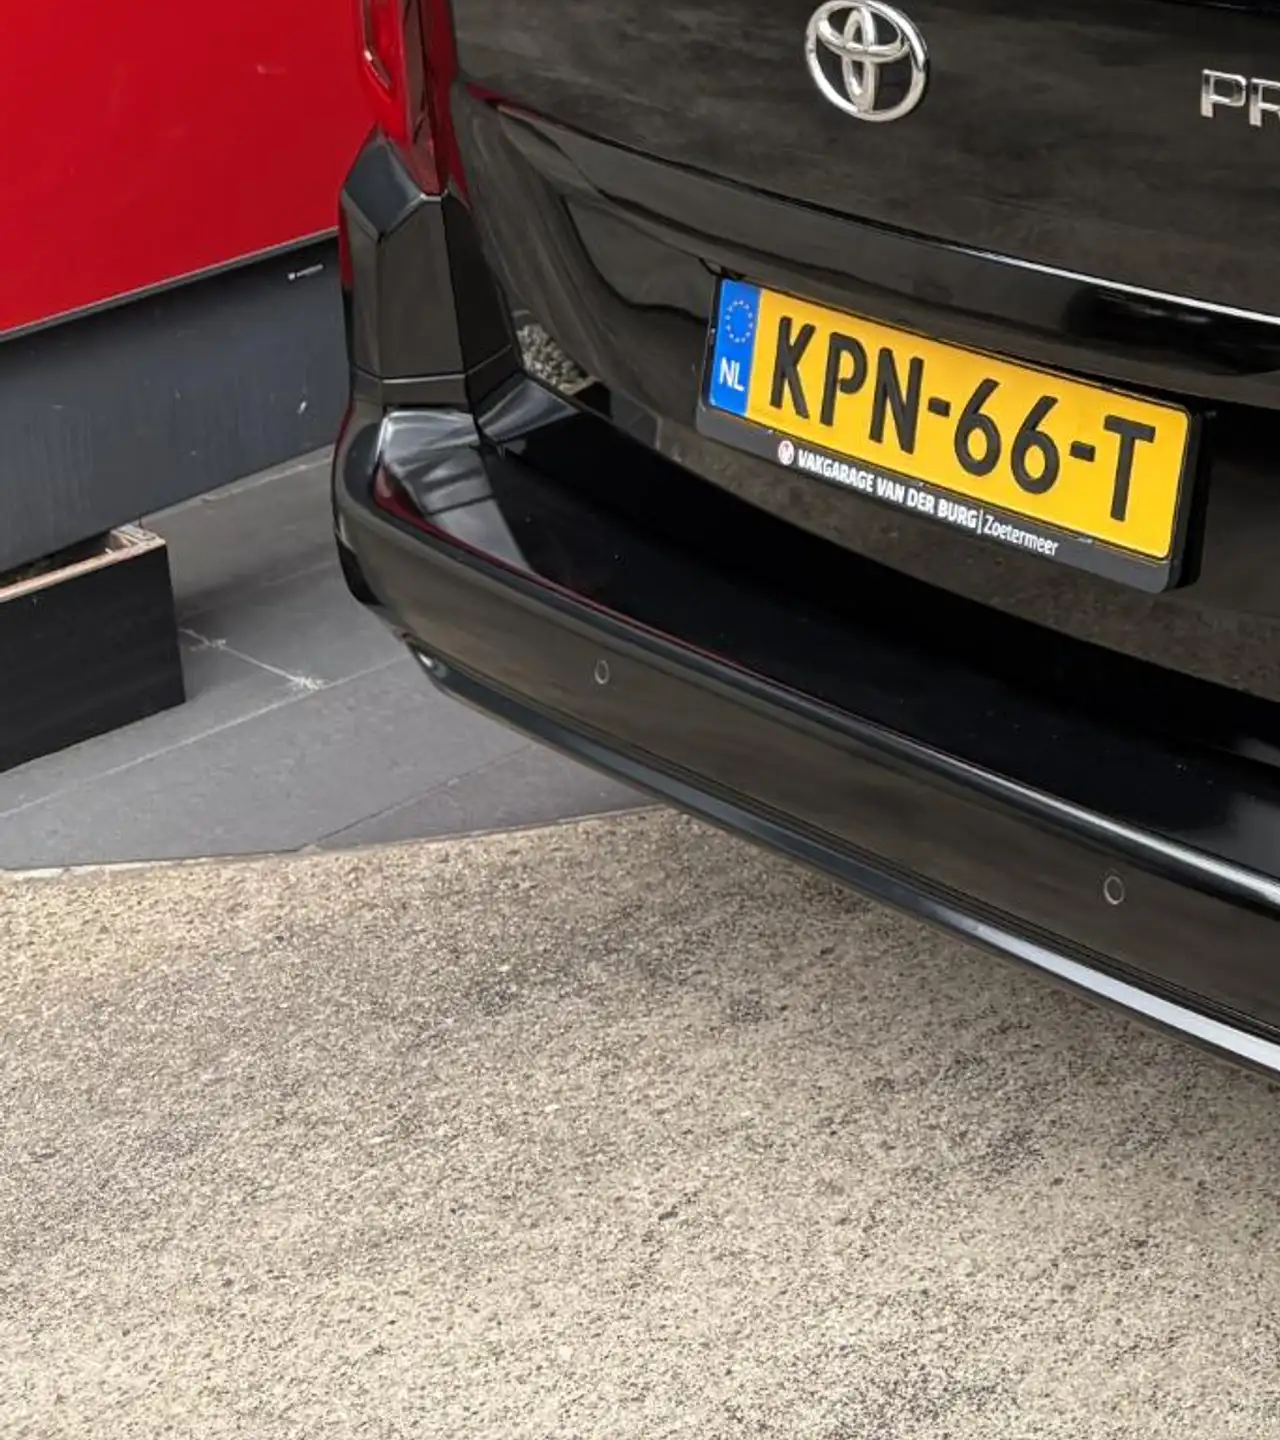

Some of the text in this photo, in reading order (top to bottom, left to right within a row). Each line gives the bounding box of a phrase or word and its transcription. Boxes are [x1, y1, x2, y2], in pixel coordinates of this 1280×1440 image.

[719, 356, 745, 391] NL
[769, 315, 1157, 523] KPN-66-T
[797, 449, 1060, 557] VAKGARAGE VAN DER BURG Zoetermeer
